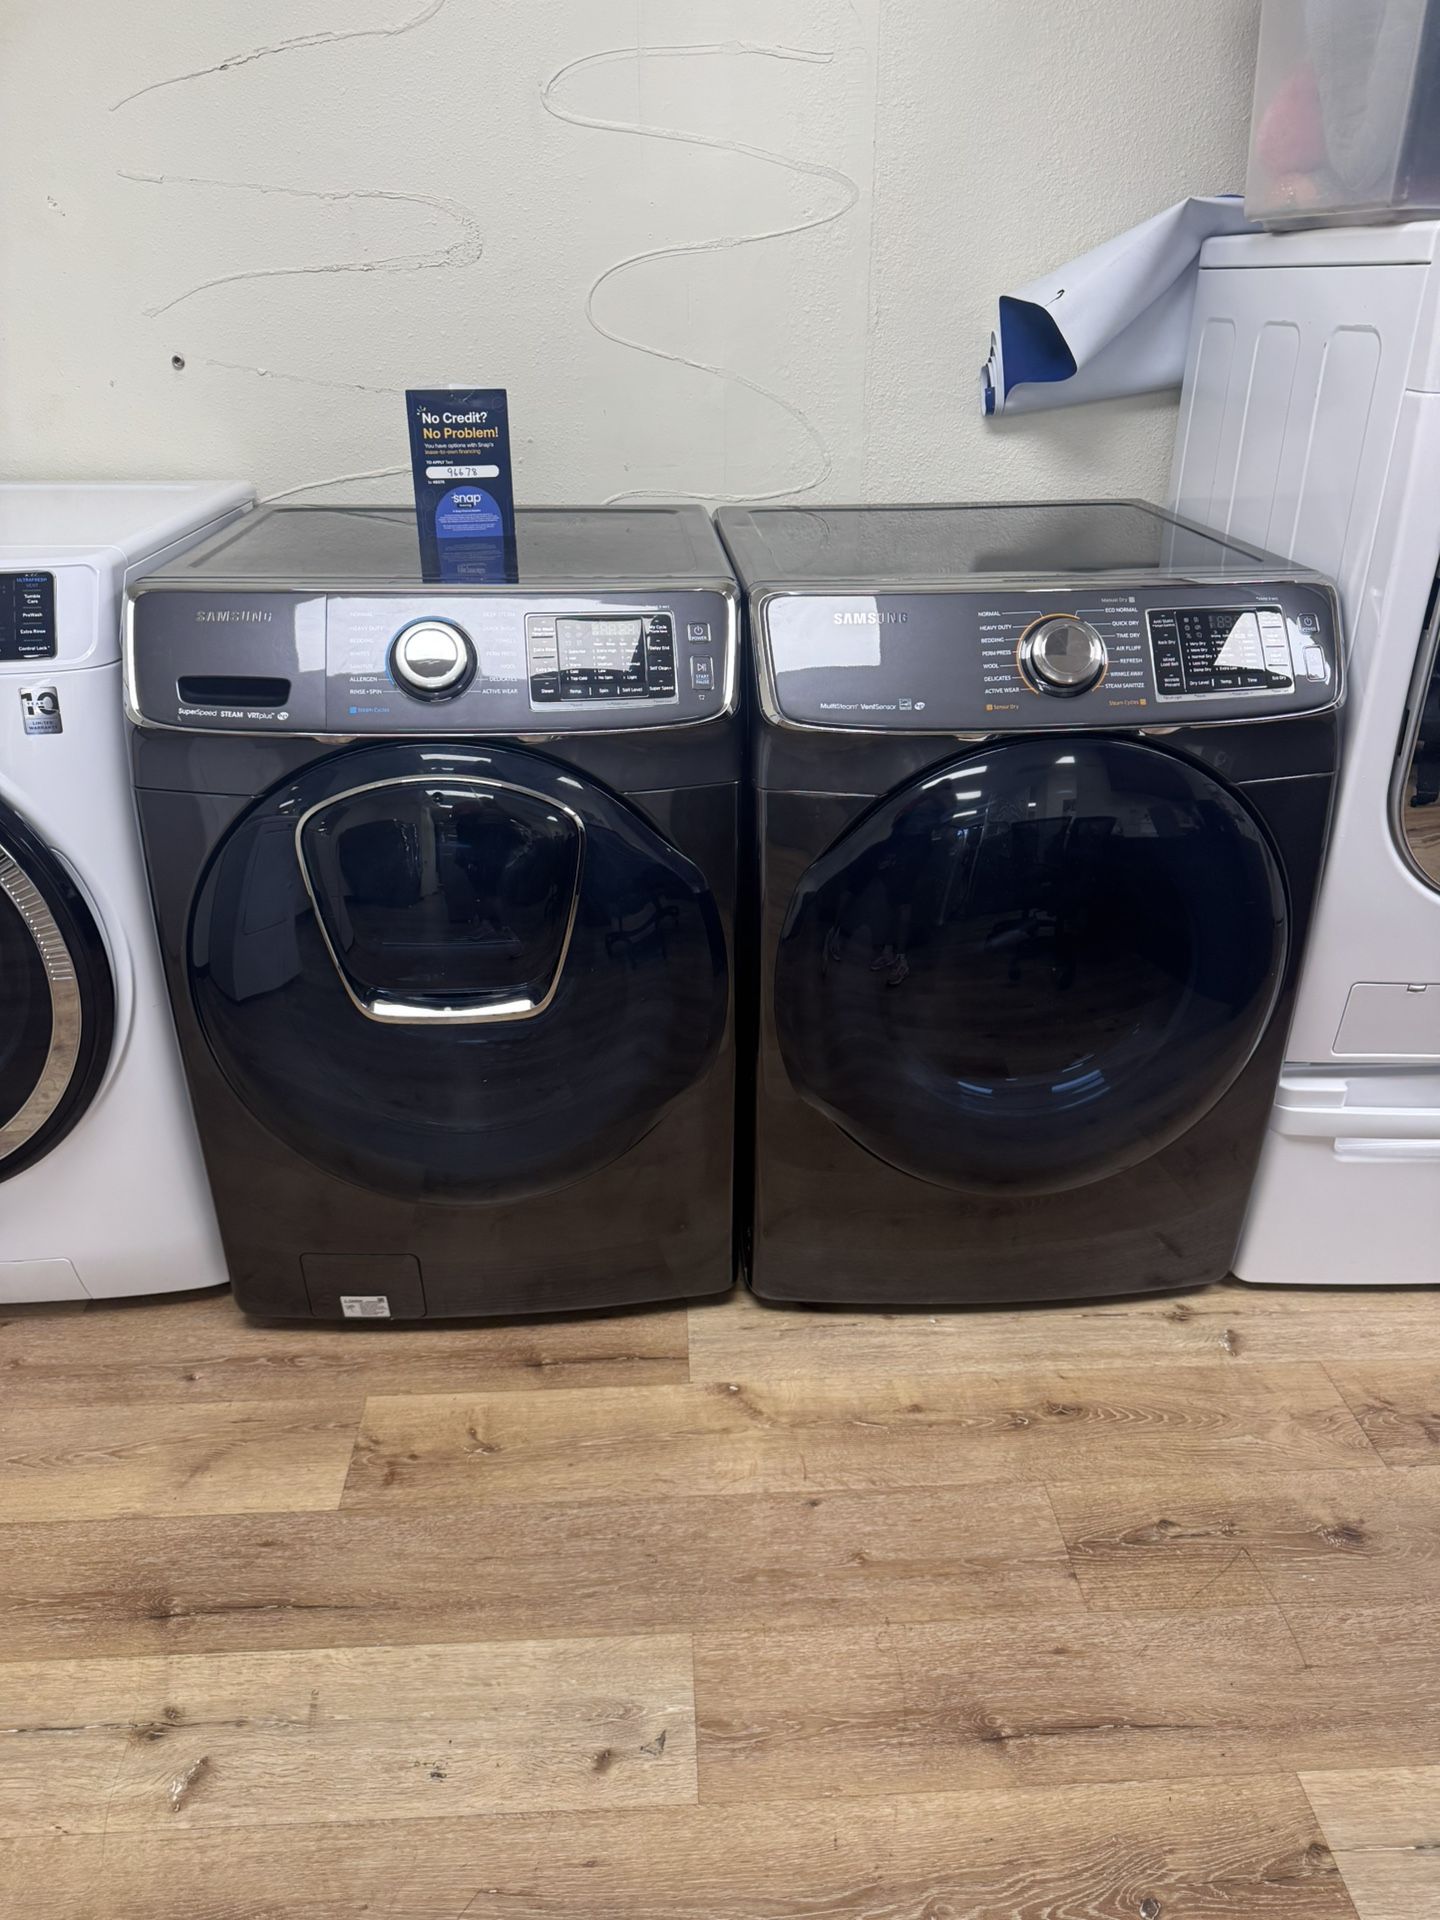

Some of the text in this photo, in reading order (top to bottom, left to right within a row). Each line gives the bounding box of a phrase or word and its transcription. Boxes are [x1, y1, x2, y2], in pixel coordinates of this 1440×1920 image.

[422, 411, 488, 424] No Credit?
[423, 426, 499, 439] No Problem!
[478, 441, 494, 449] Snap's
[459, 447, 481, 455] financing
[451, 494, 481, 505] snap
[196, 610, 272, 622] SAMSUNG
[833, 613, 908, 625] SAMSUNG
[21, 692, 60, 715] 10
[860, 703, 897, 711] VentSensor
[178, 707, 217, 717] SuperSpeed
